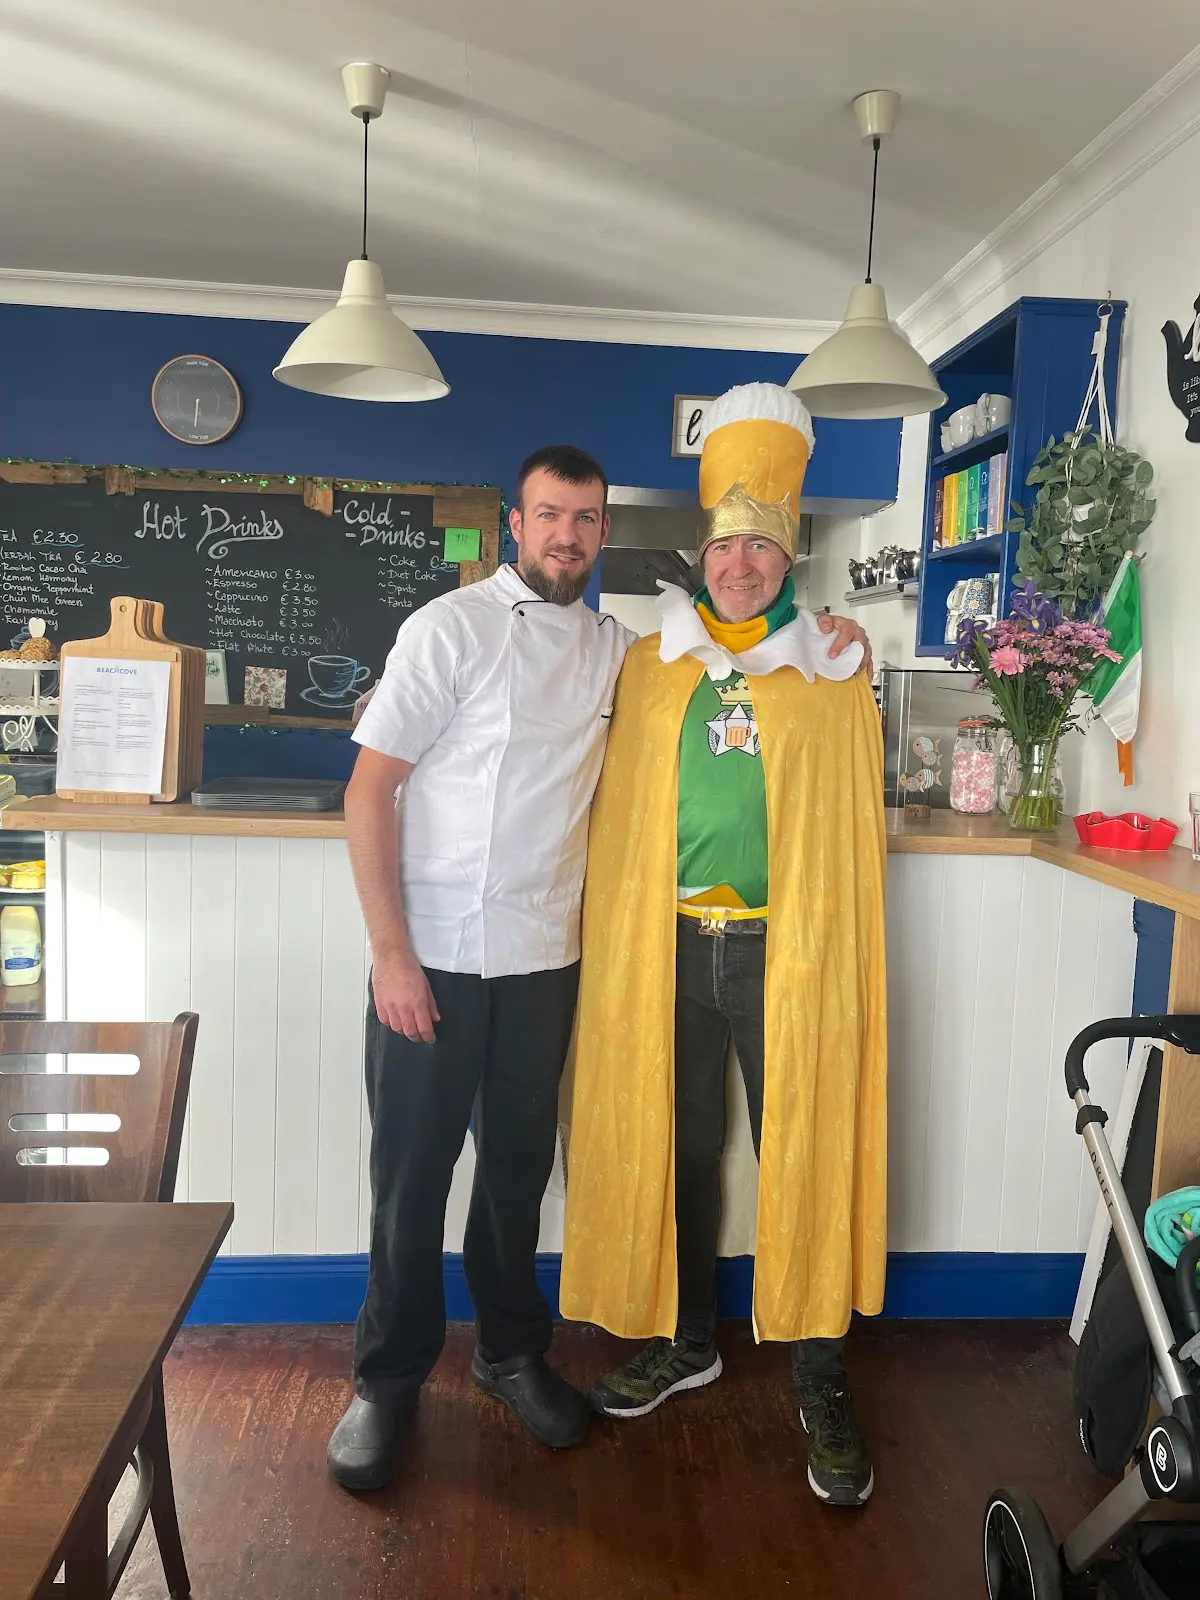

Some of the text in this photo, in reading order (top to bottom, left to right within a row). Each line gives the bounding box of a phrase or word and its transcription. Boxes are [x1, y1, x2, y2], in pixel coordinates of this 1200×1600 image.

[33, 529, 79, 544] €2.30
[134, 501, 284, 559] Hot Drinks
[39, 551, 62, 561] TEA
[389, 554, 418, 567] Coke
[2, 562, 36, 573] Rooibos
[39, 563, 65, 573] Cacao
[213, 564, 278, 579] Americano
[2, 572, 78, 585] Lemon Harmony
[387, 569, 438, 581] Diet Coke
[3, 582, 42, 596] Organic
[213, 578, 258, 590] Espresso
[387, 581, 417, 595] Sprite
[2, 594, 27, 603] Chun
[55, 596, 84, 607] Green
[214, 590, 269, 604] Cappucino
[387, 597, 413, 608] Fanta
[4, 604, 59, 616] Chamomile
[214, 602, 242, 614] Latte
[5, 615, 29, 625] Earl
[215, 614, 264, 627] Macchiato
[216, 628, 234, 637] Hot
[240, 629, 286, 642] Chocolate
[217, 640, 240, 652] Flat
[1090, 1151, 1114, 1208] DRIFT
